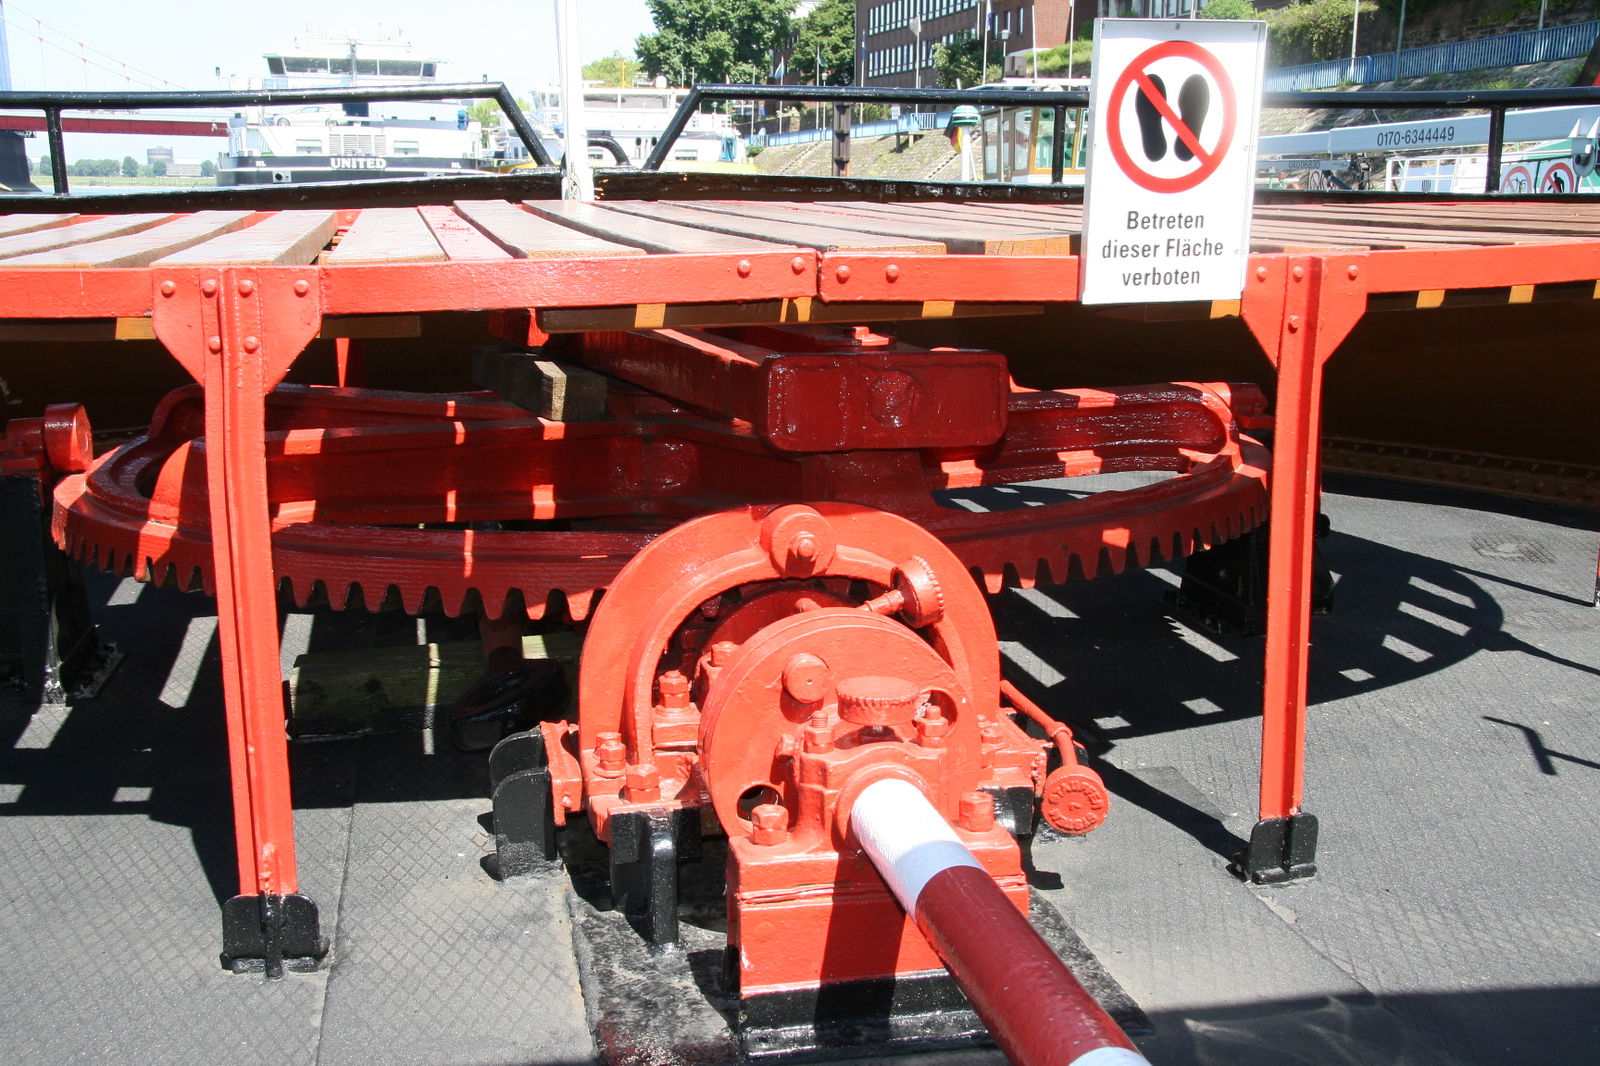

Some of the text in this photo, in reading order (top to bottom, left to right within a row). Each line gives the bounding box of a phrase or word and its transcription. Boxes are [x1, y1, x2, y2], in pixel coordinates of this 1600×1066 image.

[1377, 126, 1455, 147] 0170-6344449
[330, 157, 387, 170] UNITED
[1126, 210, 1204, 230] Betreten
[1102, 237, 1224, 259] dieser Fläche
[1122, 267, 1201, 286] verboten
